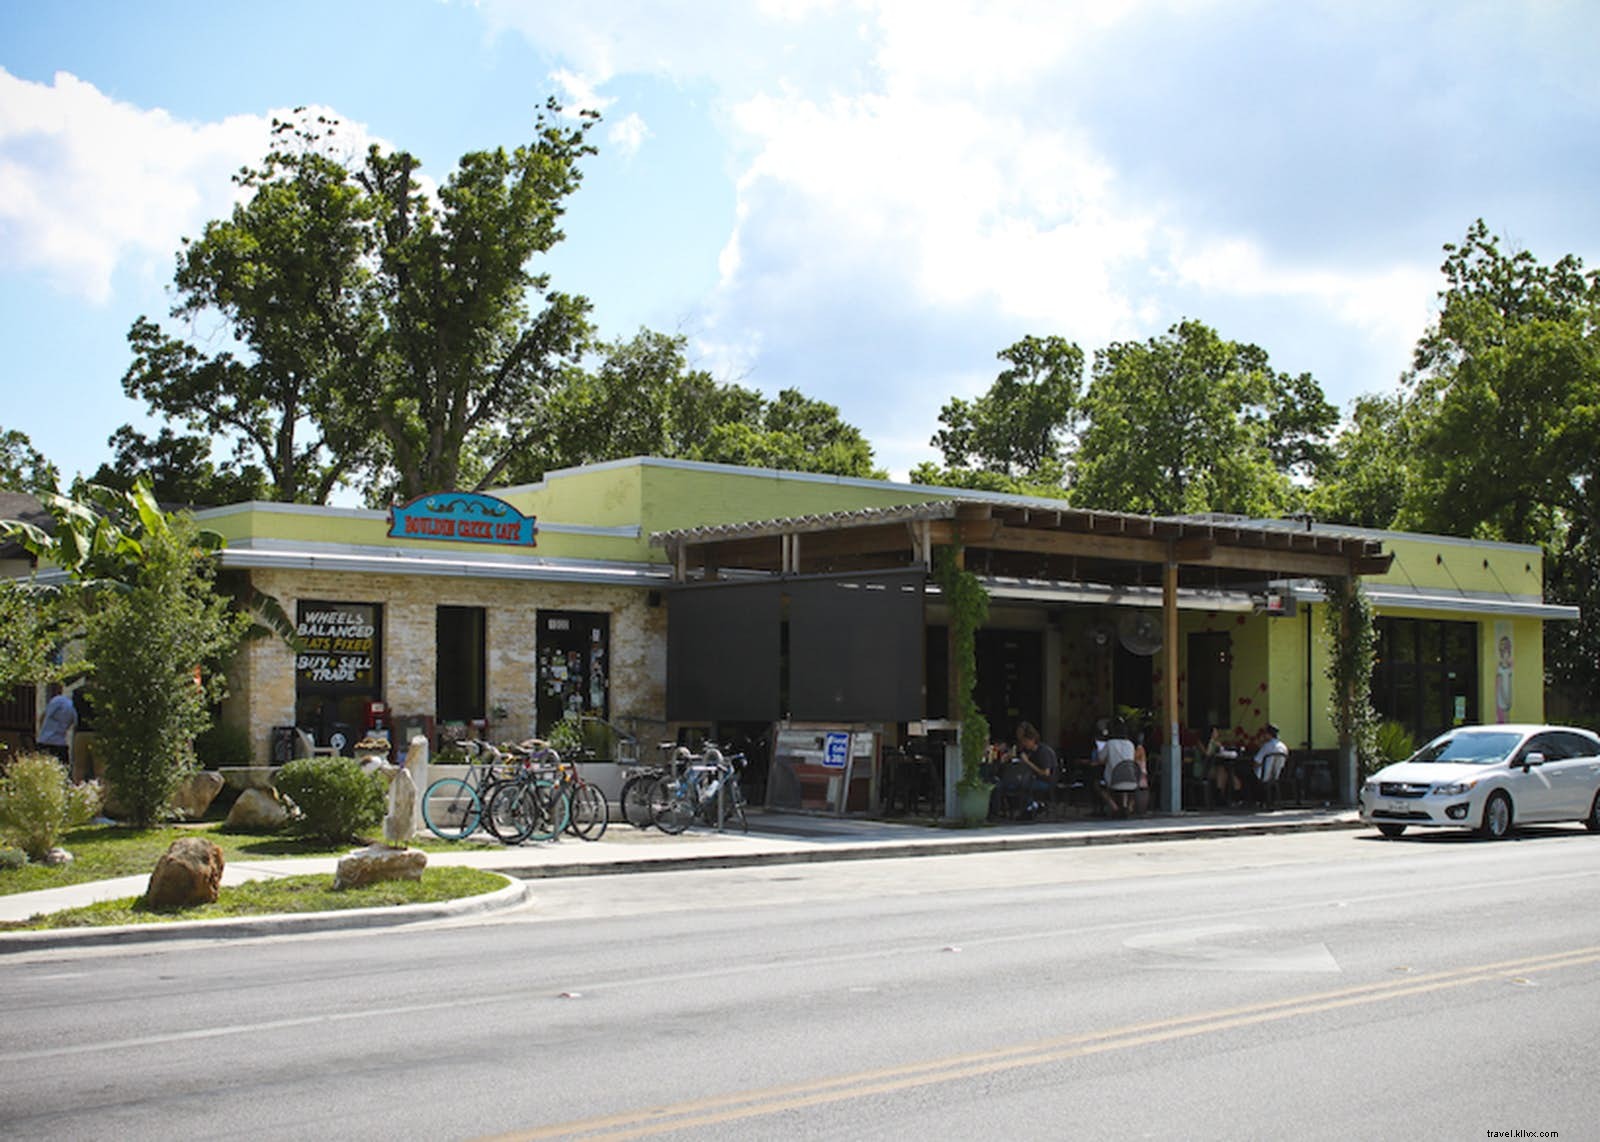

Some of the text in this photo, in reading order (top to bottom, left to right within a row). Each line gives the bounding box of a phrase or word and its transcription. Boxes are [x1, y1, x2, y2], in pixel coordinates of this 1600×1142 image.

[458, 519, 493, 539] CREEK
[305, 611, 364, 624] WHEELS
[297, 623, 375, 638] BALANCED
[333, 638, 372, 651] FIXED
[297, 656, 372, 669] BUY SELL
[313, 668, 355, 681] TRADE
